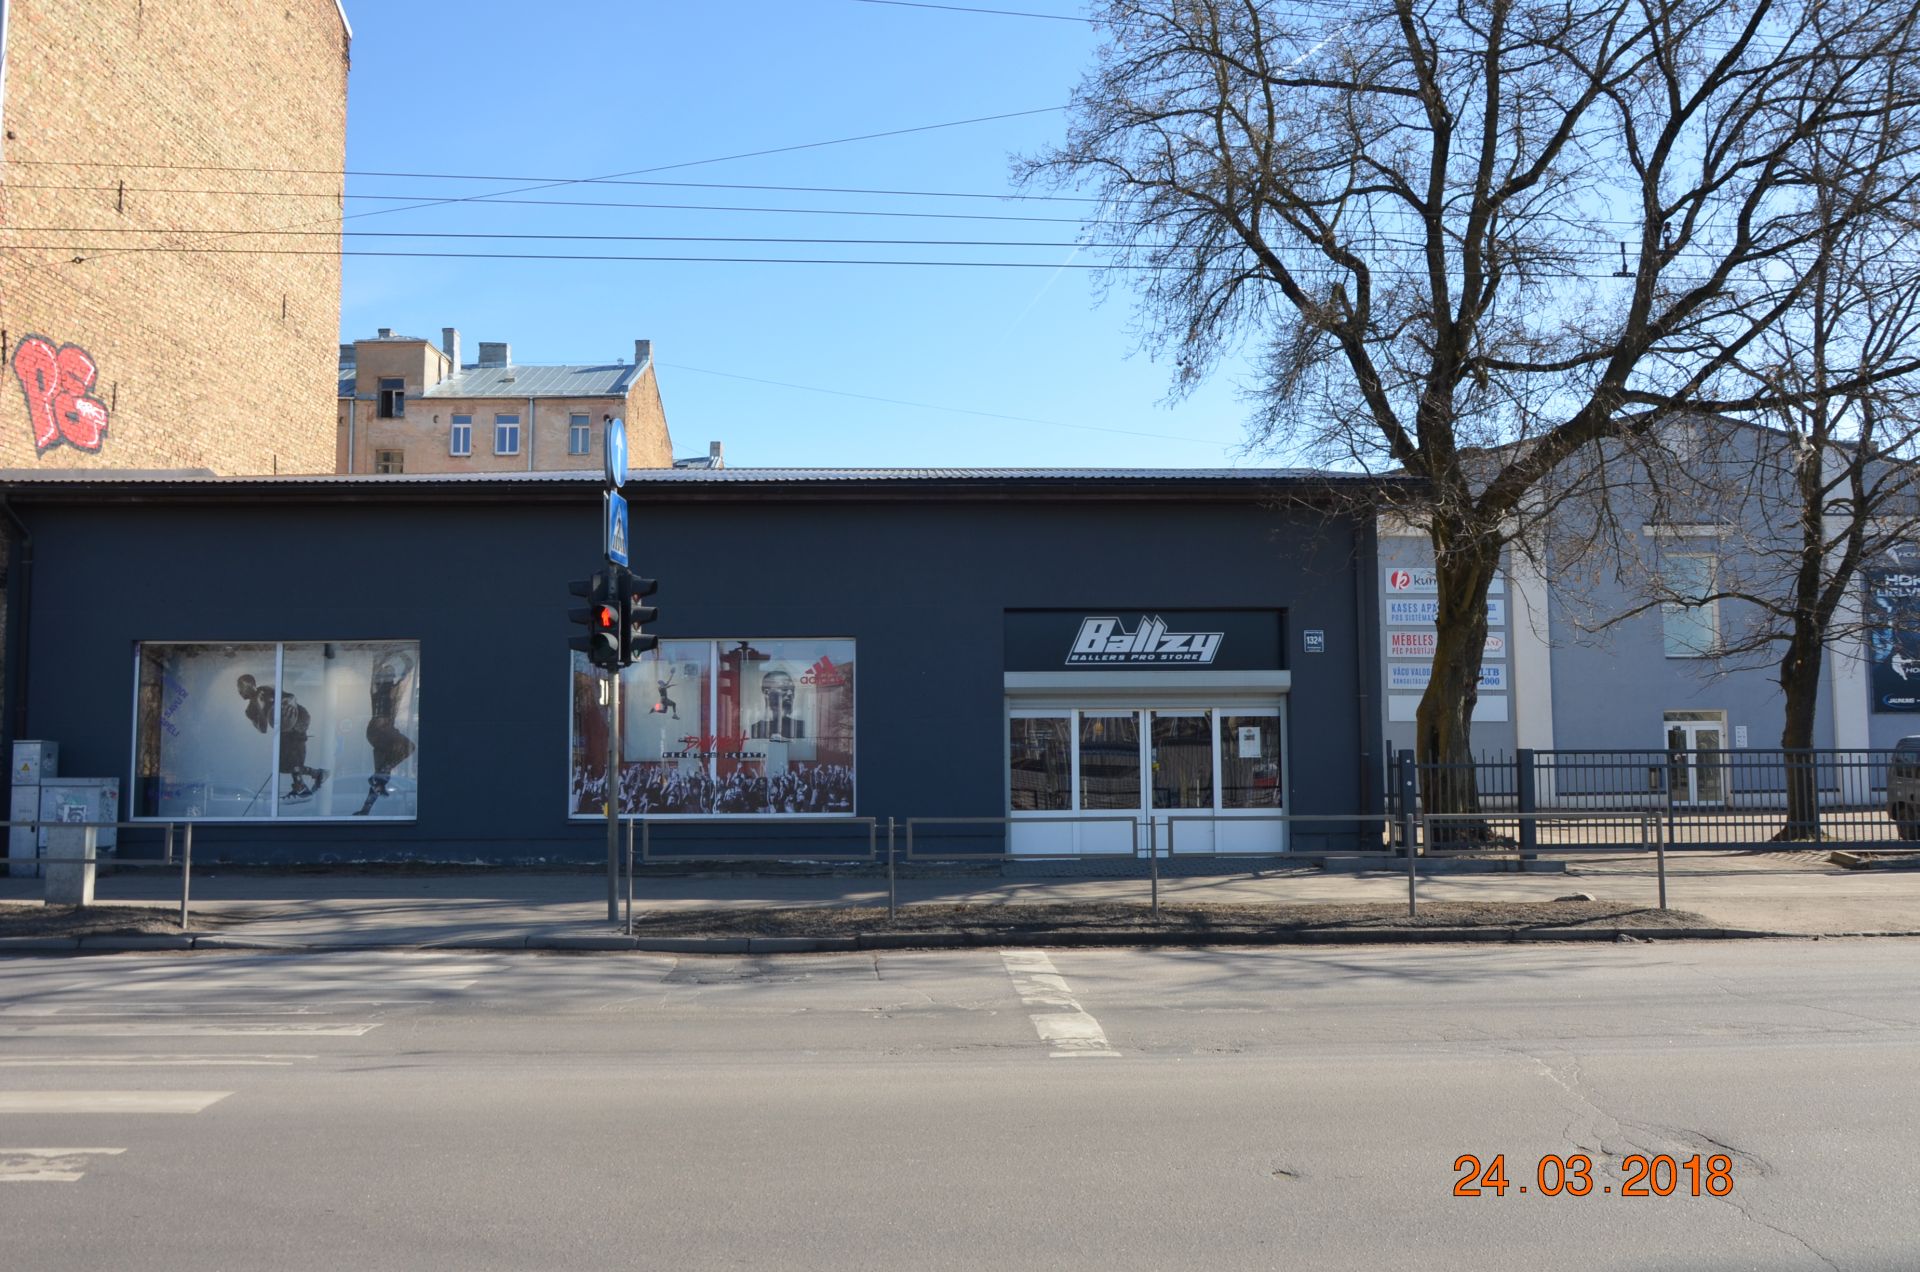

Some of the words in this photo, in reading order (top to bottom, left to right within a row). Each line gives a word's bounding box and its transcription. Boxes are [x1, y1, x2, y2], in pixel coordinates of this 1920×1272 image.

[1391, 603, 1418, 613] KASES
[1073, 617, 1221, 662] Ballzy
[1392, 632, 1434, 646] MĒBELES
[1392, 646, 1403, 655] PĒC
[1393, 666, 1410, 676] VĀCU
[1480, 668, 1500, 676] LTB
